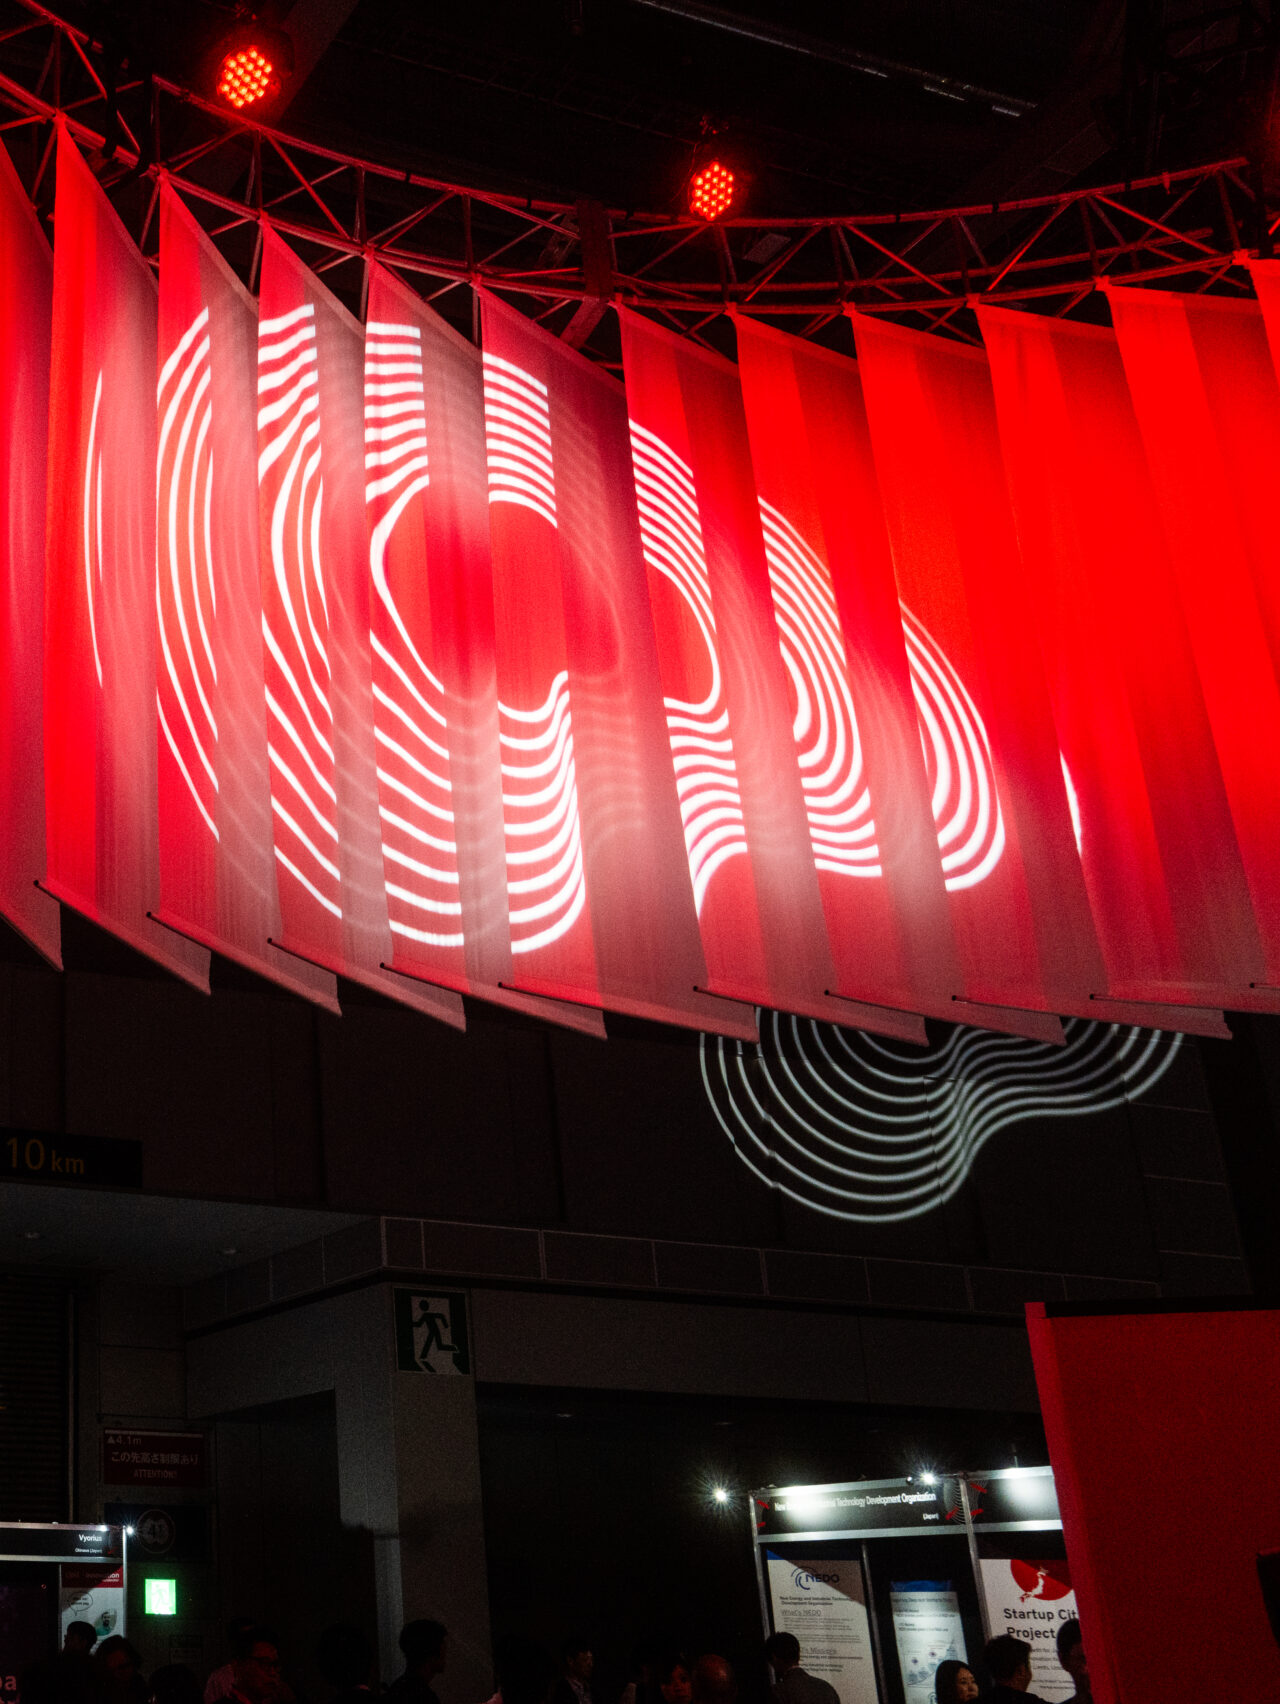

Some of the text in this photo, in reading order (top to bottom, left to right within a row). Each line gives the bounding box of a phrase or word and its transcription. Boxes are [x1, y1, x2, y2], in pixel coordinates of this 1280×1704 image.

[866, 1494, 901, 1507] Development
[901, 1491, 937, 1505] Organization
[805, 1573, 840, 1584] NEDO
[1003, 1607, 1078, 1622] Startup Cit
[1006, 1626, 1058, 1641] Project
